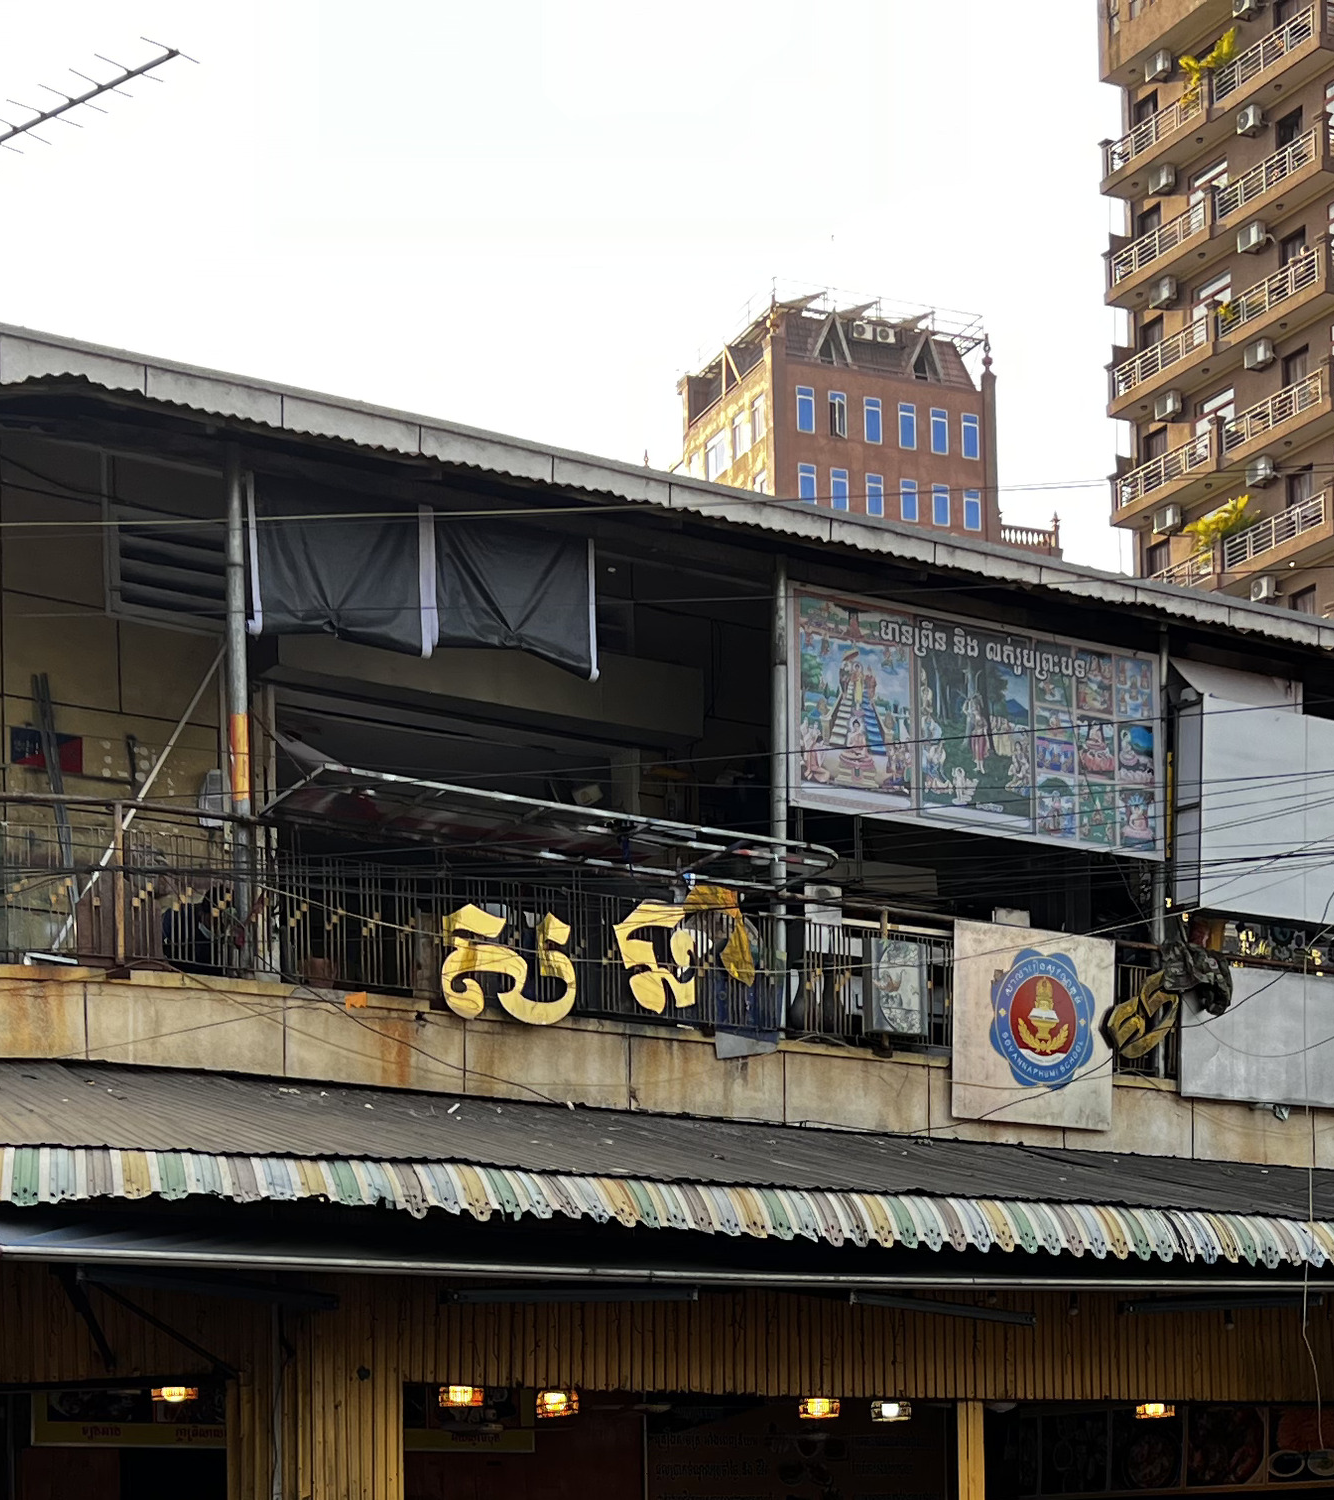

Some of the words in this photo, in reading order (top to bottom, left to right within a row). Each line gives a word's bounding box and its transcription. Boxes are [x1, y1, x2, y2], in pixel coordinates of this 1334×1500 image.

[953, 626, 980, 658] និង
[1002, 1031, 1059, 1078] SOVANNAPHUMI
[1059, 1040, 1084, 1074] SCHOOL
